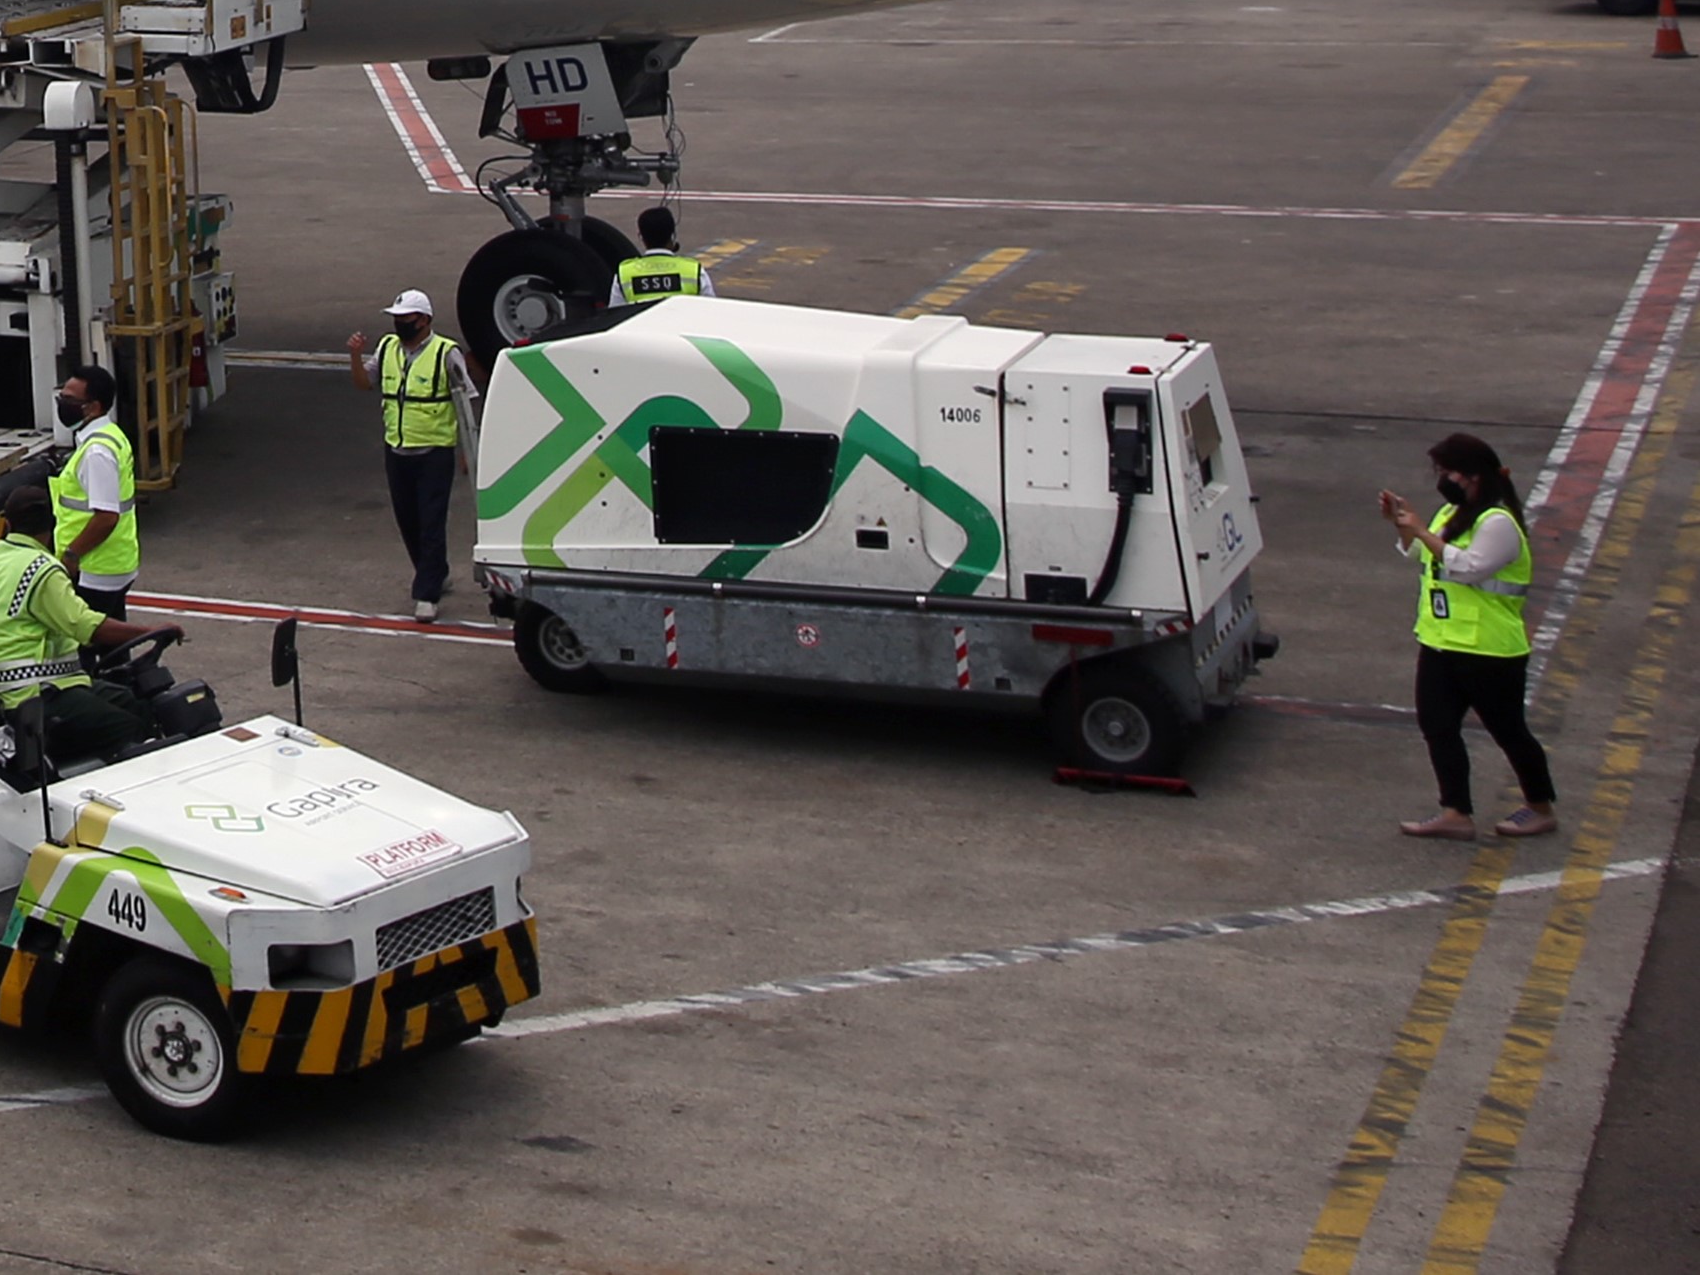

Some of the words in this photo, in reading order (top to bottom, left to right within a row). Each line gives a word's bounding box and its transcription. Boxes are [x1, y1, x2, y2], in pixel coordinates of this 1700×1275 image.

[524, 57, 589, 95] HD
[940, 407, 982, 424] 14006
[266, 778, 381, 818] Gapura
[365, 831, 449, 868] PLATFORM
[108, 888, 147, 932] 449
